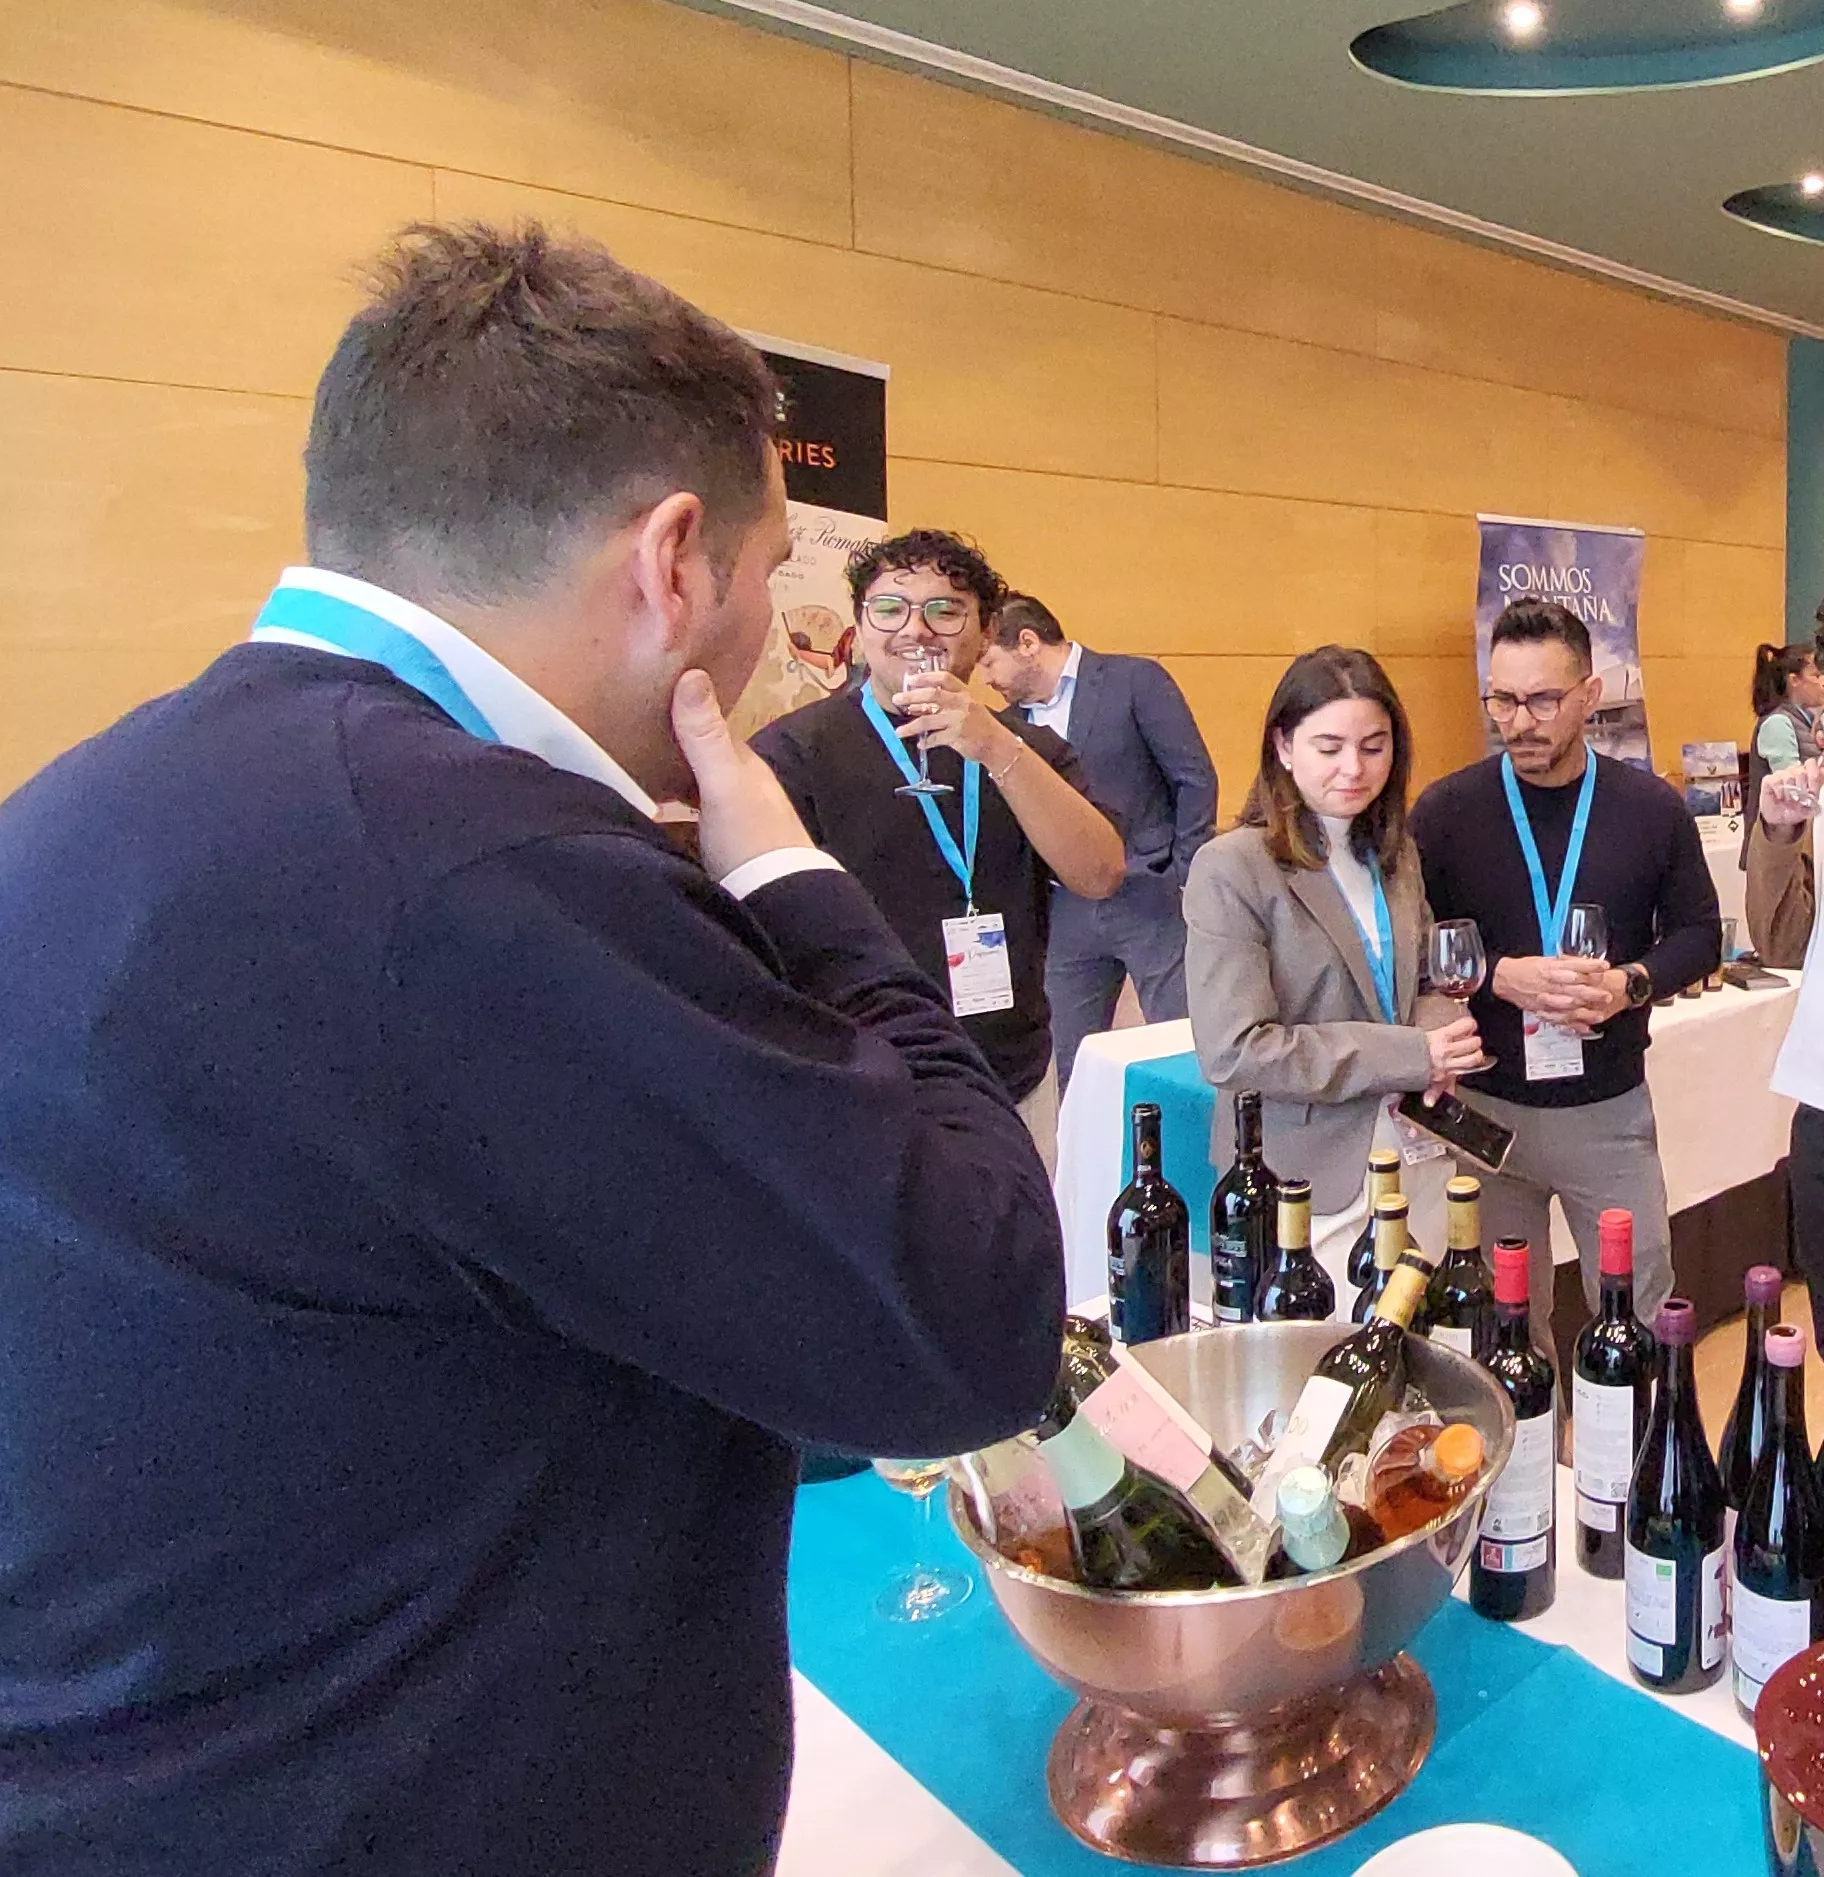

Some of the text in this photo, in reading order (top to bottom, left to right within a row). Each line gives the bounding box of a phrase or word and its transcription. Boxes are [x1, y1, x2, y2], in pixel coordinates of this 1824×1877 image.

[779, 439, 837, 469] RIES
[809, 515, 873, 554] Romat
[1498, 563, 1592, 594] SOMMOS
[1504, 594, 1615, 624] TAÑA
